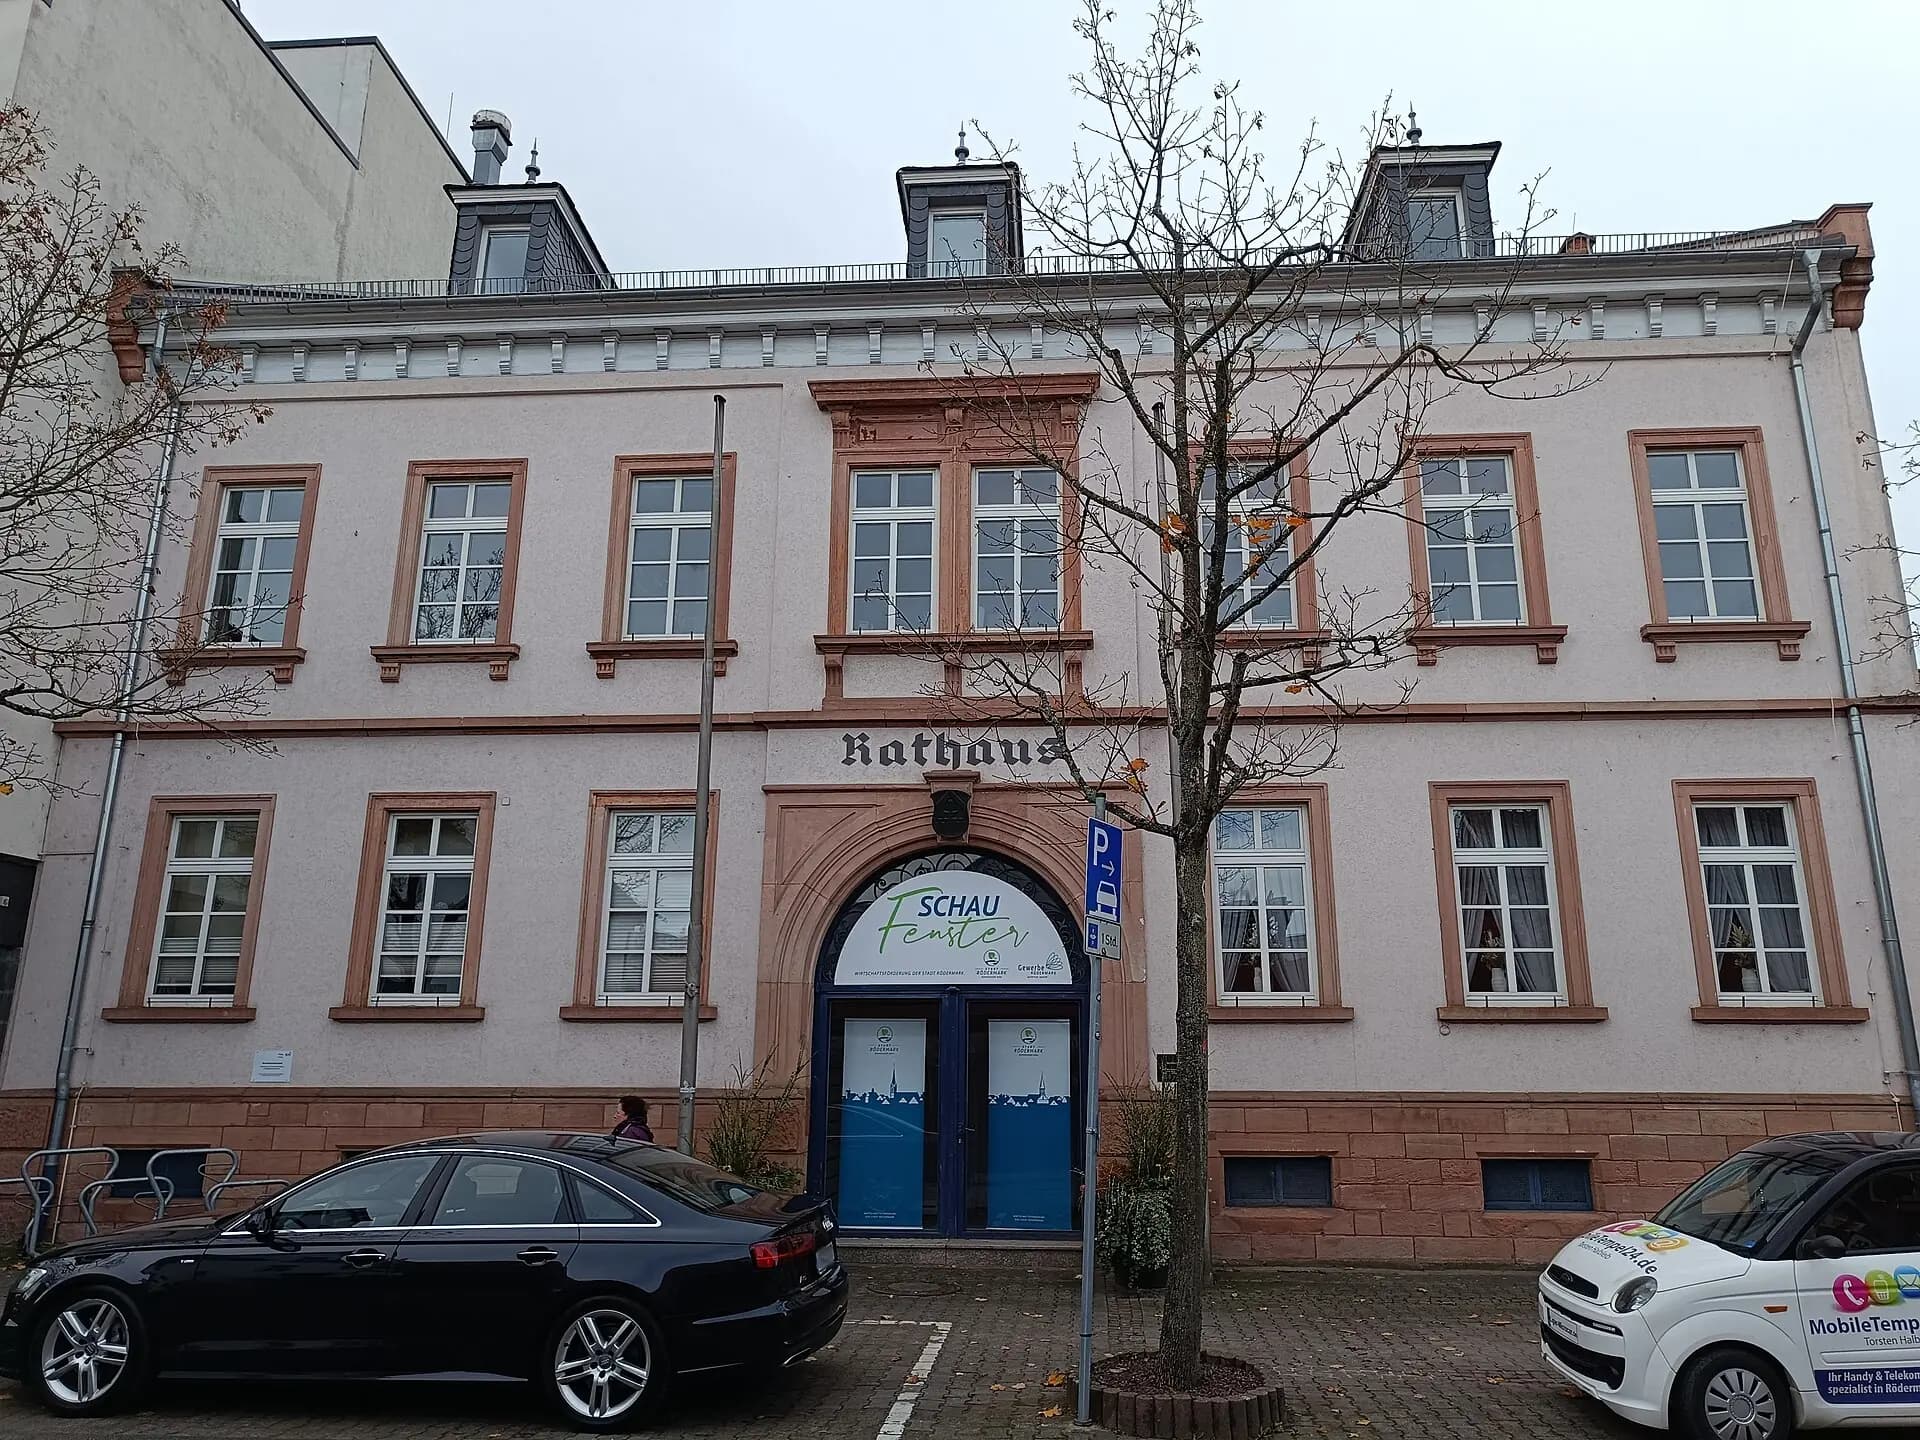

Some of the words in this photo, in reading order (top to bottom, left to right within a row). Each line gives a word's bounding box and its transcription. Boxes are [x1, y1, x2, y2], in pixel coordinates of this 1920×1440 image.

[841, 731, 1067, 770] Rathaus
[1093, 826, 1109, 866] P
[917, 895, 1001, 917] SCHAU
[878, 886, 1030, 954] Fenster
[1105, 934, 1119, 948] Std.
[1017, 964, 1045, 972] Gewerbe
[1809, 1316, 1920, 1335] MobileTemp
[1864, 1336, 1899, 1346] Torsten
[1828, 1371, 1842, 1382] Ihr
[1843, 1371, 1874, 1383] Handy
[1875, 1371, 1883, 1380] &
[1828, 1384, 1873, 1396] spezialist
[1874, 1384, 1883, 1393] in
